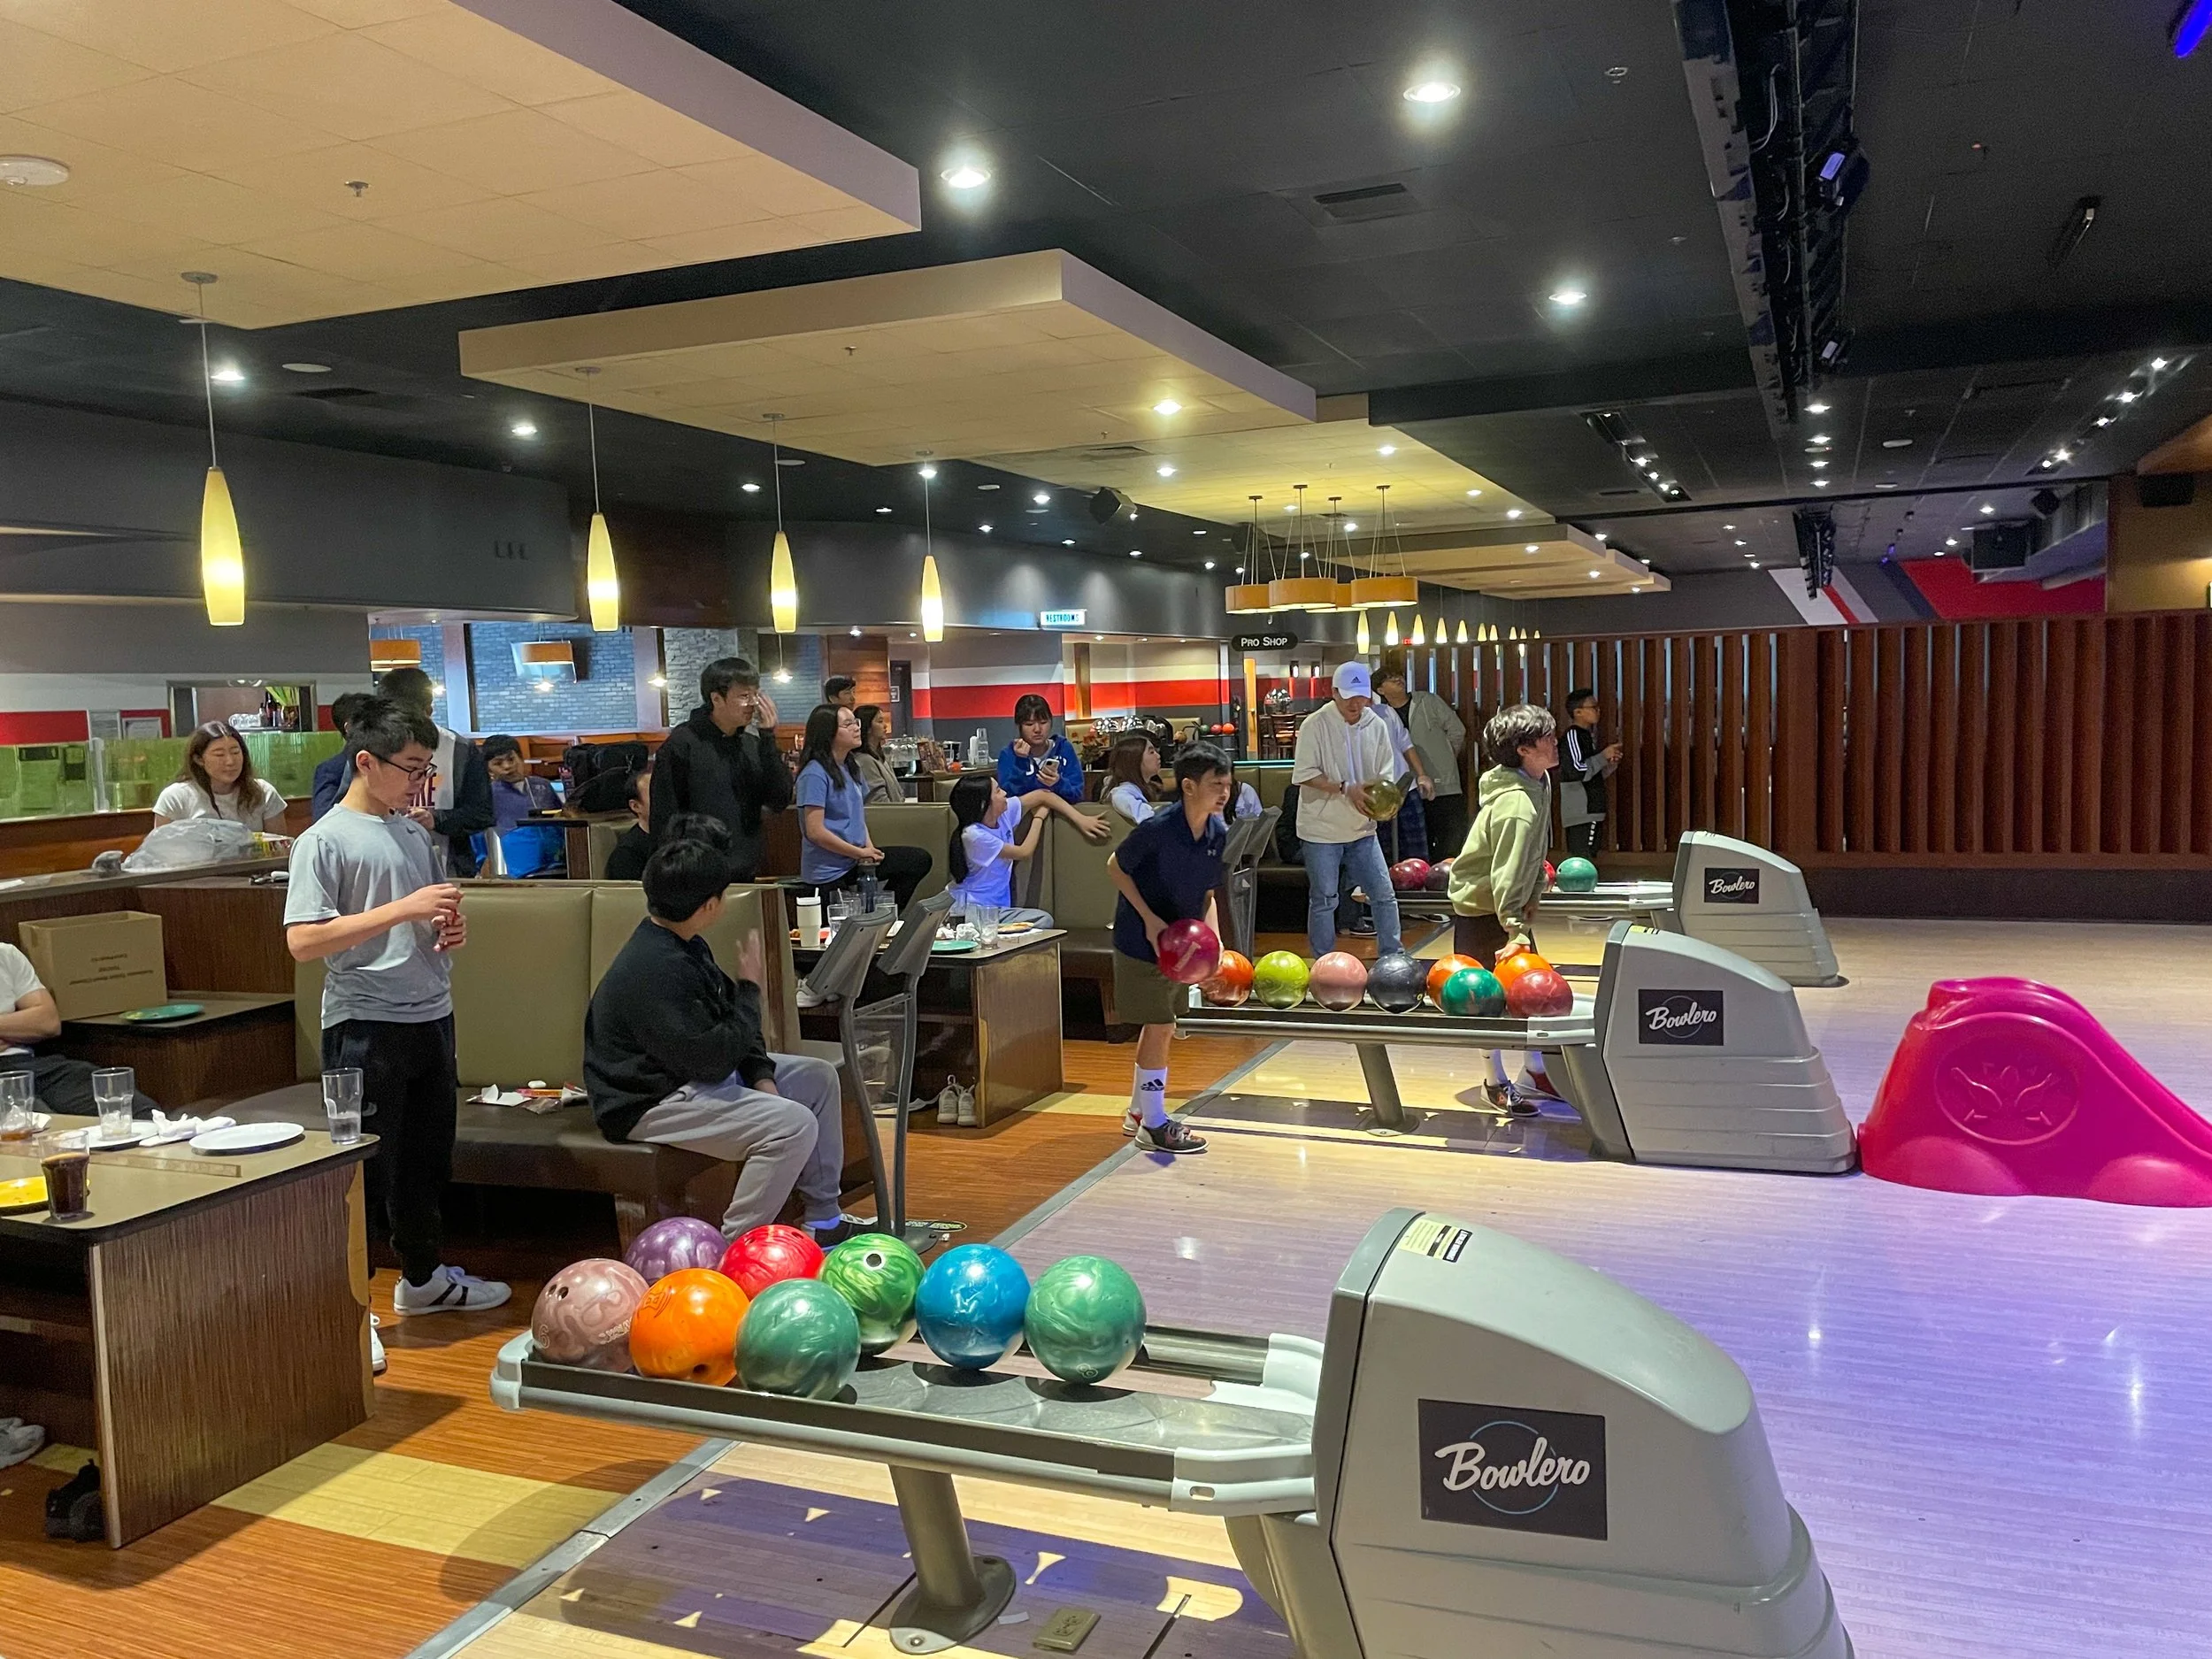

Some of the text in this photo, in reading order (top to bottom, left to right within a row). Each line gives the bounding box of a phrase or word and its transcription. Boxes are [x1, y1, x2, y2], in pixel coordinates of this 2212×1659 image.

[1045, 613, 1080, 623] RESTROOMS
[1240, 636, 1288, 647] PRO SHOP
[1708, 875, 1755, 895] Bowlero
[1645, 1002, 1717, 1030] Bowlero
[1434, 1436, 1591, 1491] Bowlero
